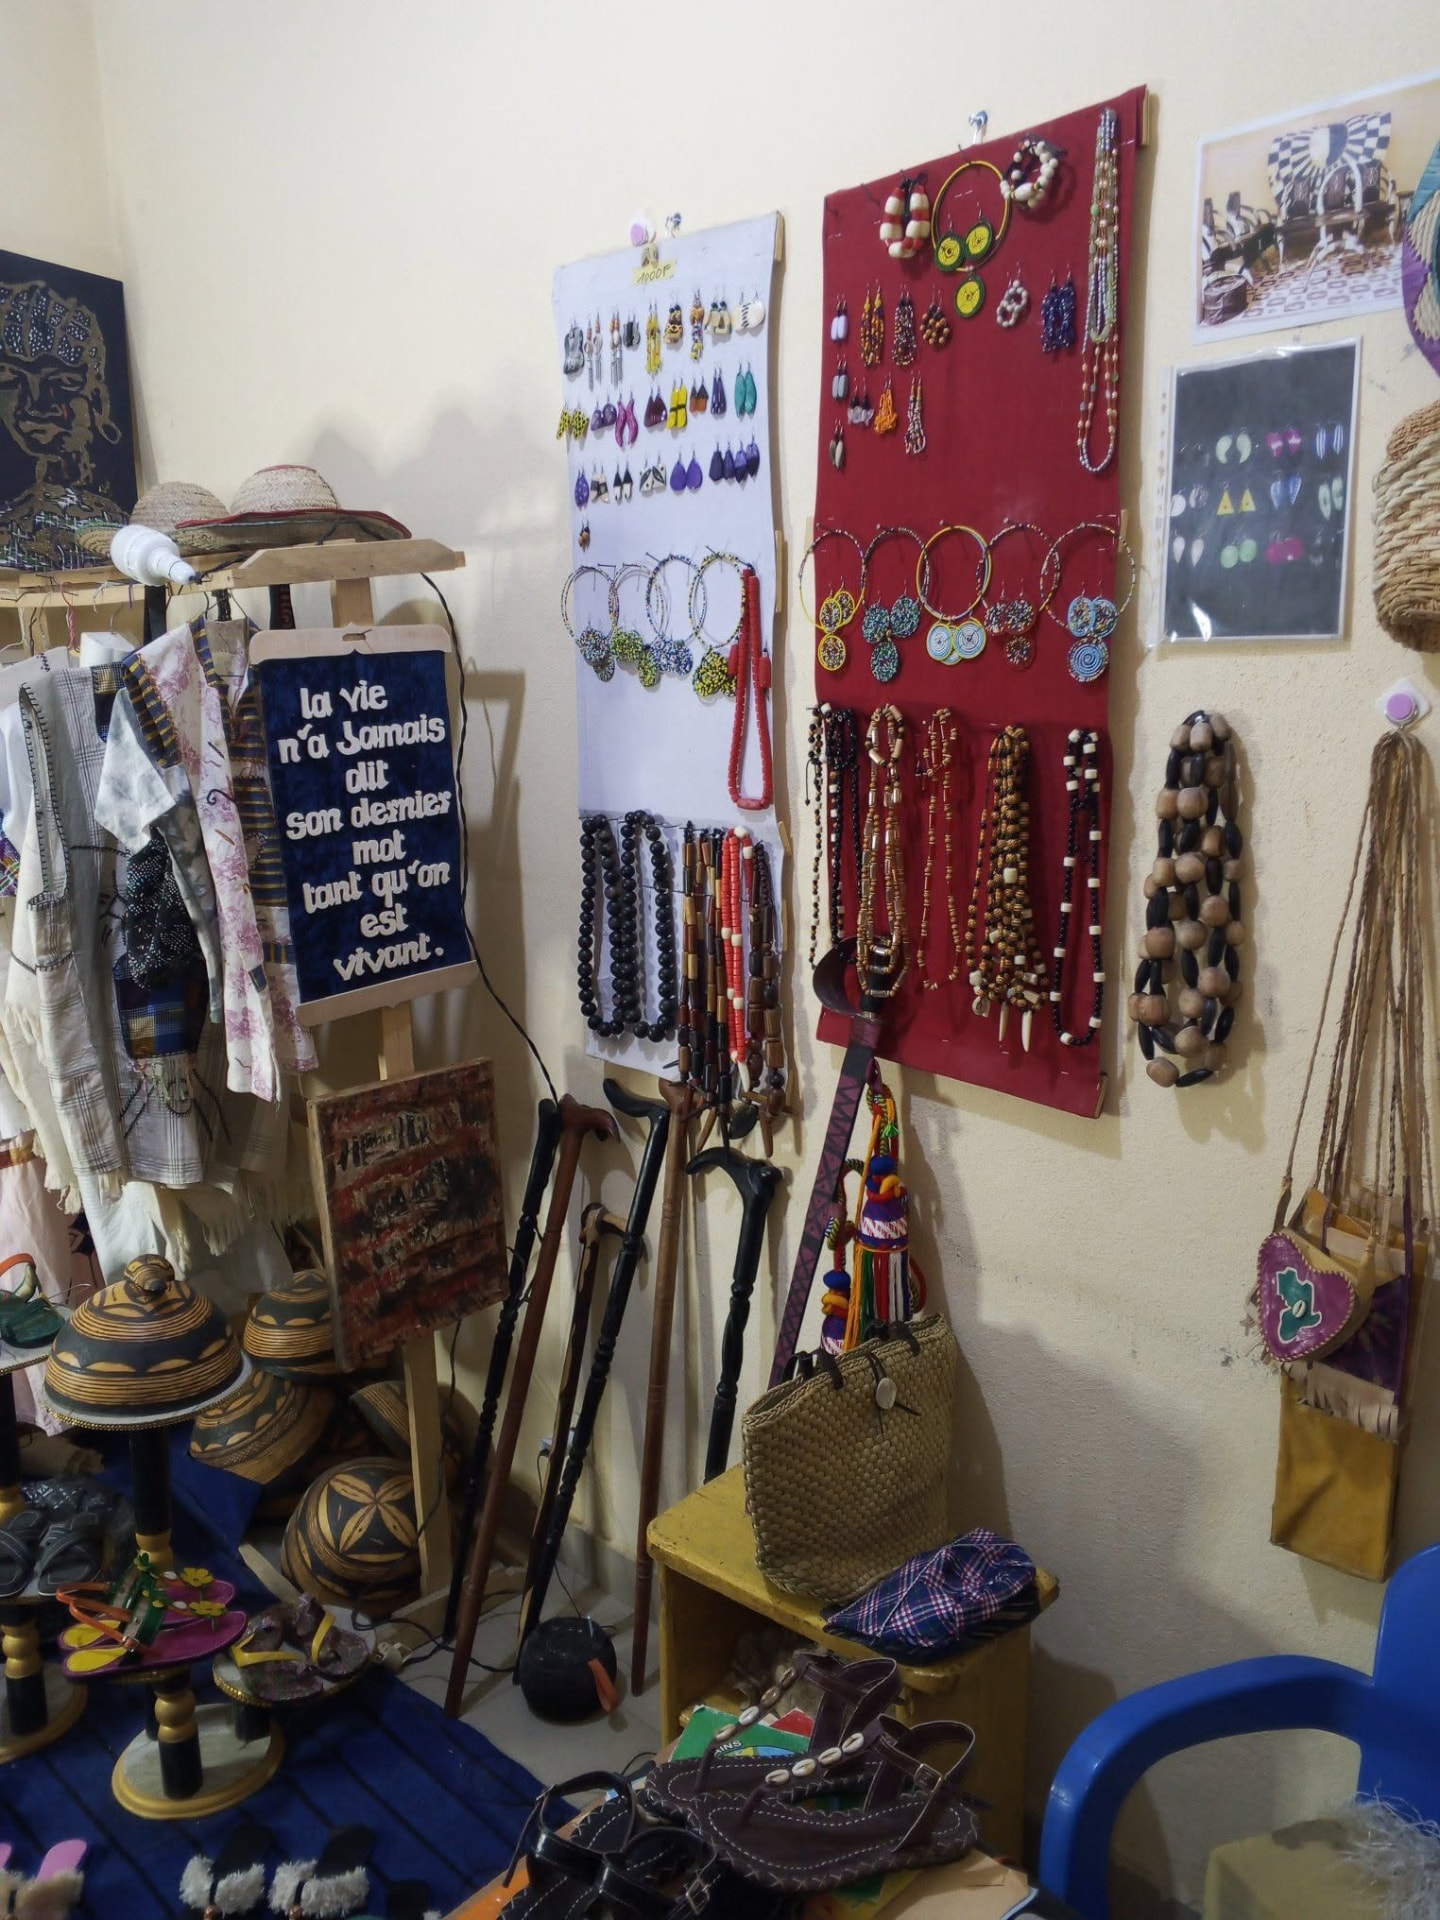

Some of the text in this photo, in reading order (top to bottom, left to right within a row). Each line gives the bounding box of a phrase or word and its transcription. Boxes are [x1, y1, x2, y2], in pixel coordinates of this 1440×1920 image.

[637, 263, 672, 283] 1000F
[300, 680, 388, 719] la vie
[336, 714, 446, 756] Jamais
[345, 760, 390, 794] dit
[286, 790, 452, 840] son dernier
[352, 829, 407, 866] mot
[302, 871, 363, 914] tant
[360, 902, 409, 938] est
[333, 932, 445, 981] vivant.
